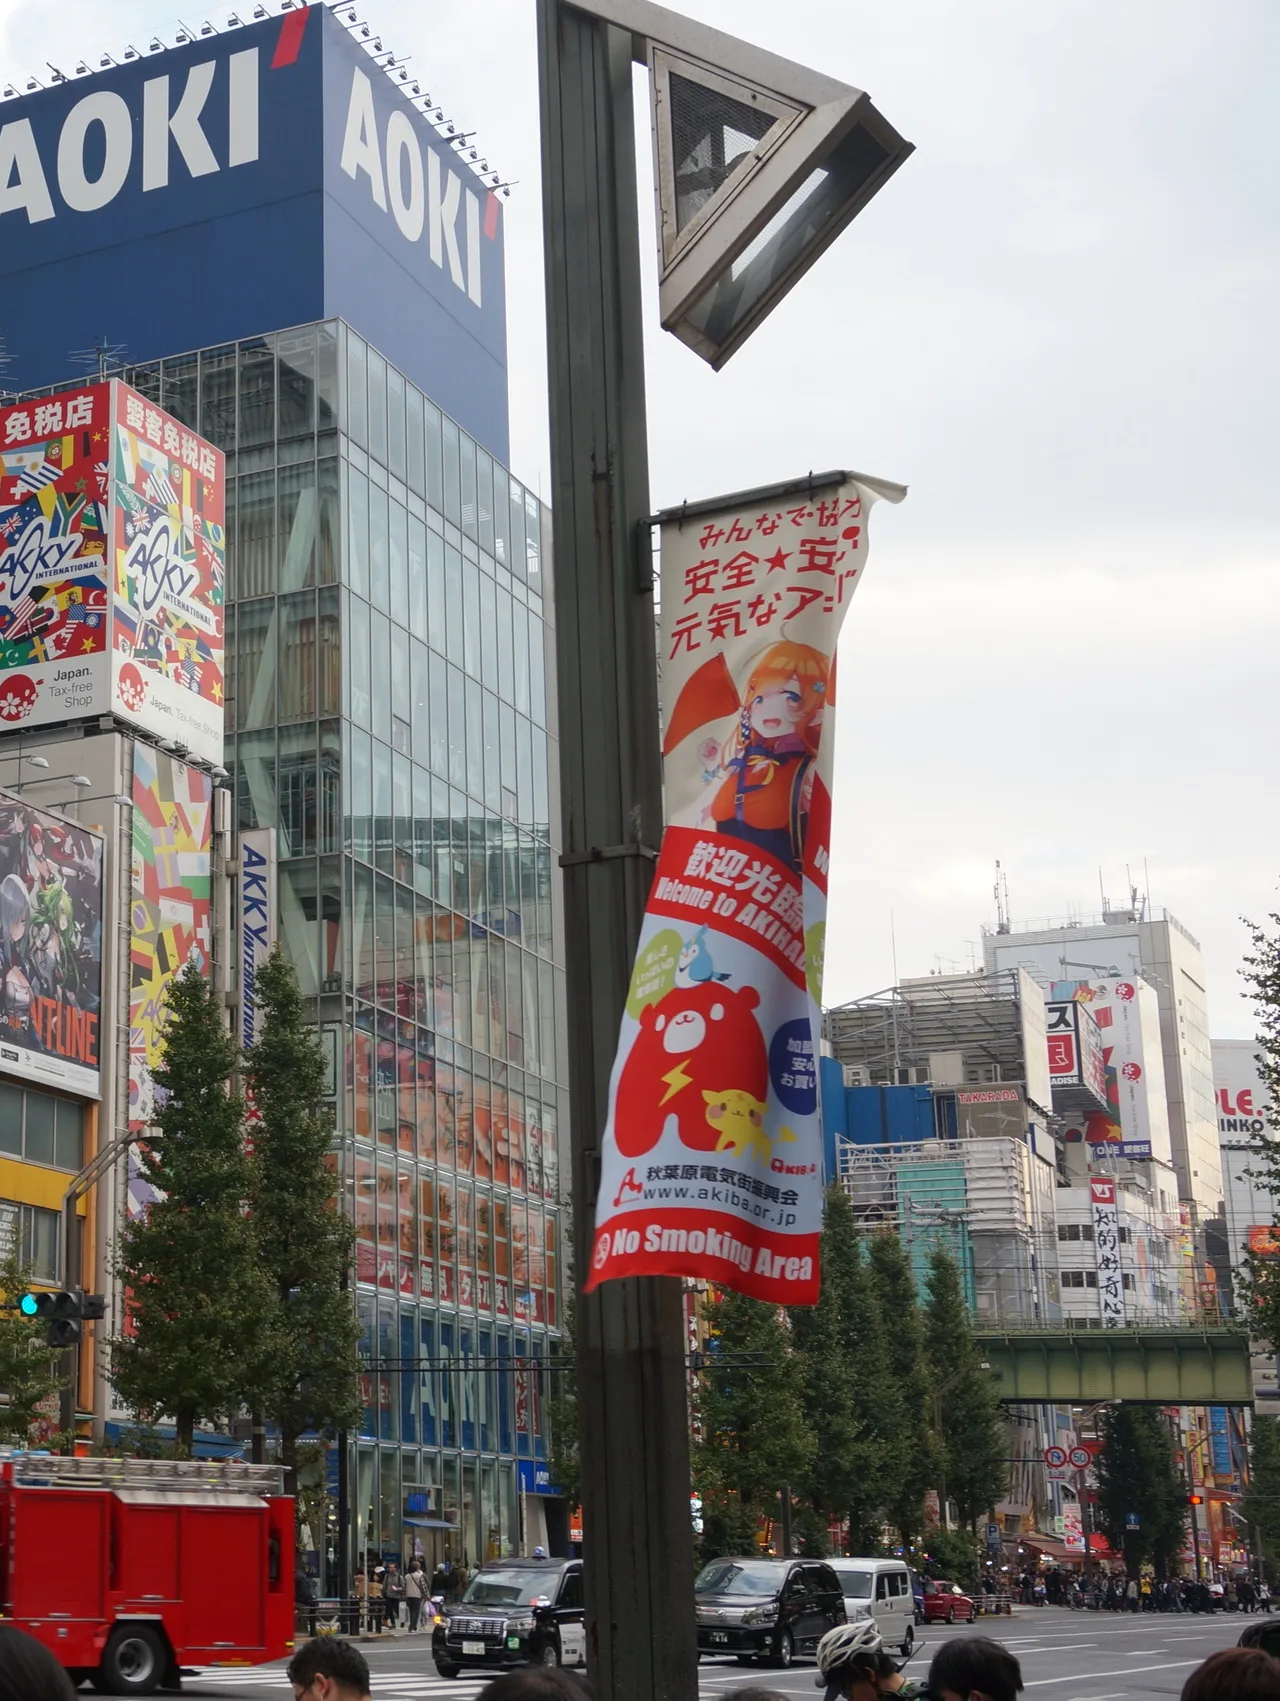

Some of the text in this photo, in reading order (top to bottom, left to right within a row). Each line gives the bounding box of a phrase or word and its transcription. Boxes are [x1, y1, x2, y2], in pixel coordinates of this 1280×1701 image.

[341, 66, 481, 308] AOKI
[4, 395, 94, 445] 免税店
[126, 394, 216, 483] 愛客免税店
[35, 561, 99, 580] INTERNATIONAL
[163, 590, 212, 627] INTERNATIONAL
[49, 681, 93, 698] Tax-free
[53, 666, 93, 682] Japan.
[64, 694, 93, 709] Shop
[243, 843, 268, 948] AKKY
[654, 877, 714, 911] Welcome
[712, 892, 739, 917] to
[958, 1089, 1019, 1104] TAKARADA
[646, 1165, 799, 1207] 秋葉原電気街振興会
[643, 1187, 797, 1227] www.akiba.or.jp
[611, 1223, 813, 1281] No Smoking Area
[1073, 1452, 1087, 1463] 50
